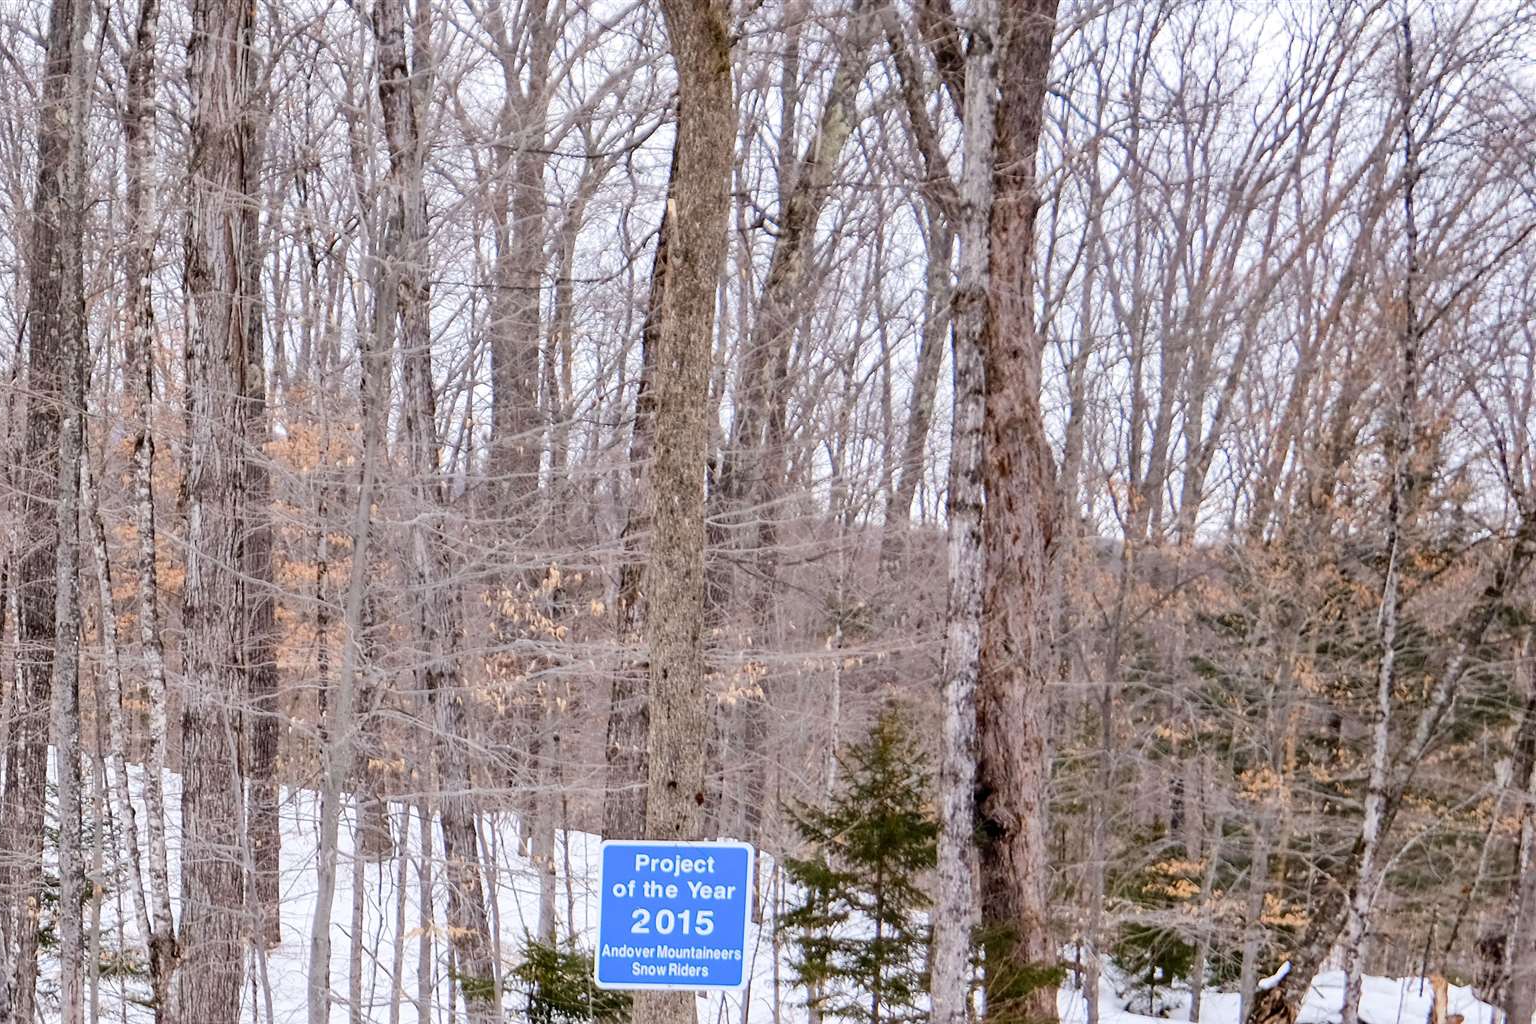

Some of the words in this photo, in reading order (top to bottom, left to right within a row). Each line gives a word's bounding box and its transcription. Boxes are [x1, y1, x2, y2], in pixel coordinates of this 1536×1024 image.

[635, 854, 715, 877] Project
[612, 880, 636, 898] of
[643, 880, 678, 899] the
[687, 880, 736, 900] Year
[630, 908, 714, 936] 2015
[602, 943, 655, 958] Andover
[656, 944, 741, 960] Mountaineers
[631, 961, 667, 976] Snow
[668, 962, 709, 977] Riders
